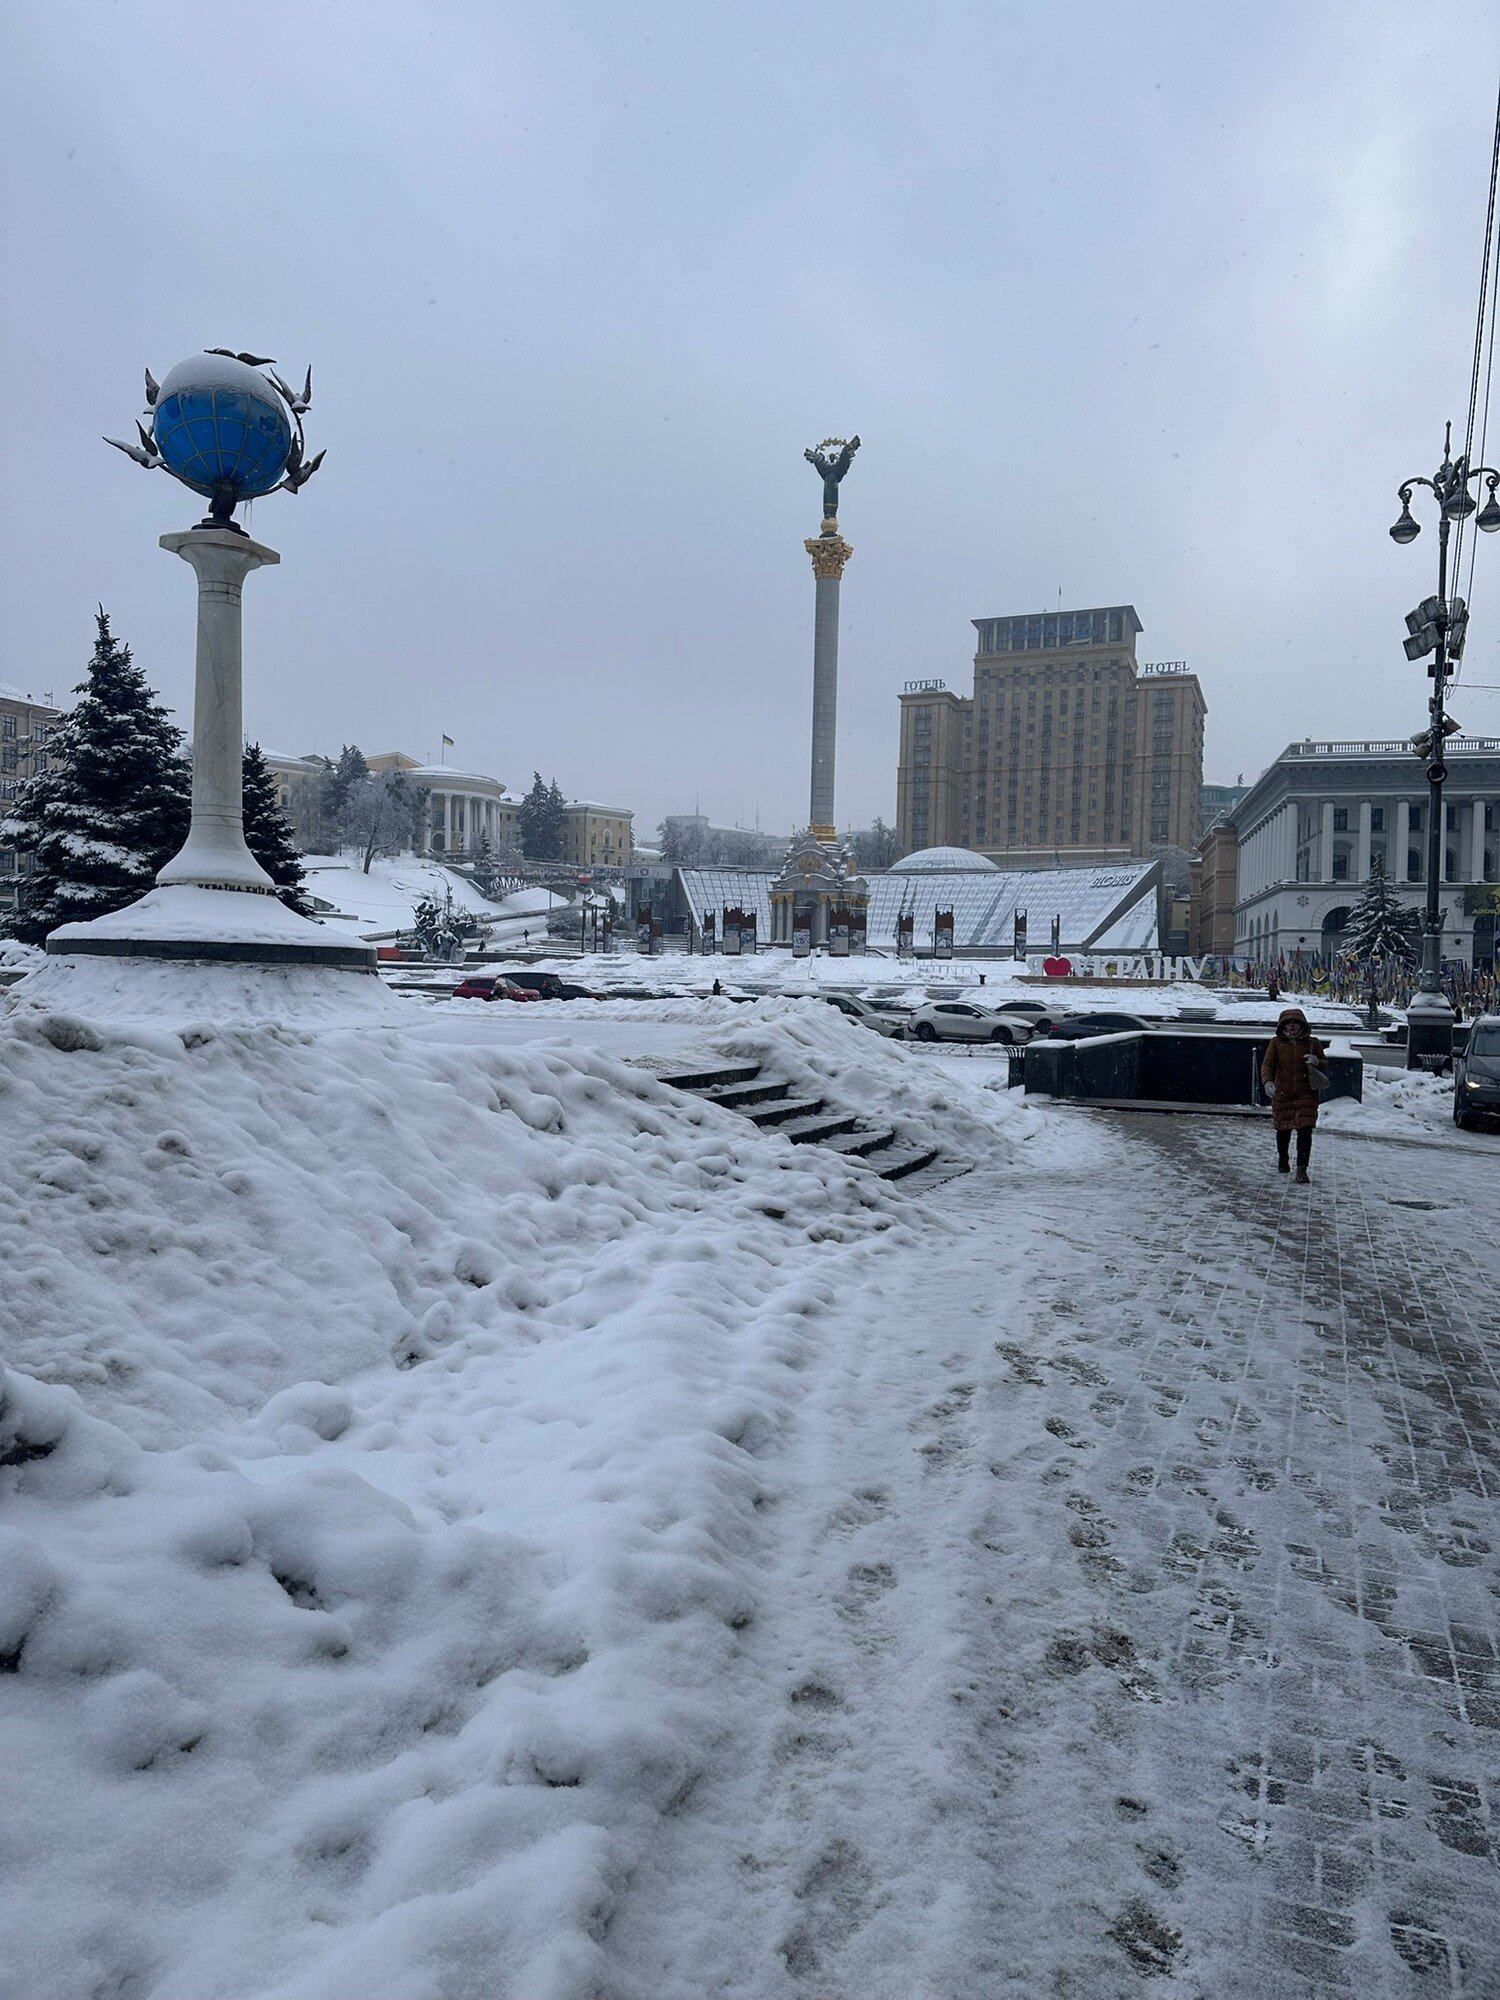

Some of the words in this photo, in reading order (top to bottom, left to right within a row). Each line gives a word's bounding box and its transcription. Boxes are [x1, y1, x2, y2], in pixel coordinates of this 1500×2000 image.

[1144, 661, 1191, 674] HOTEL
[904, 679, 946, 691] ГОТЕЛЬ
[1090, 874, 1137, 888] GLOBUS
[1027, 956, 1044, 977] Я
[1071, 951, 1210, 981] УКРАЇНУ
